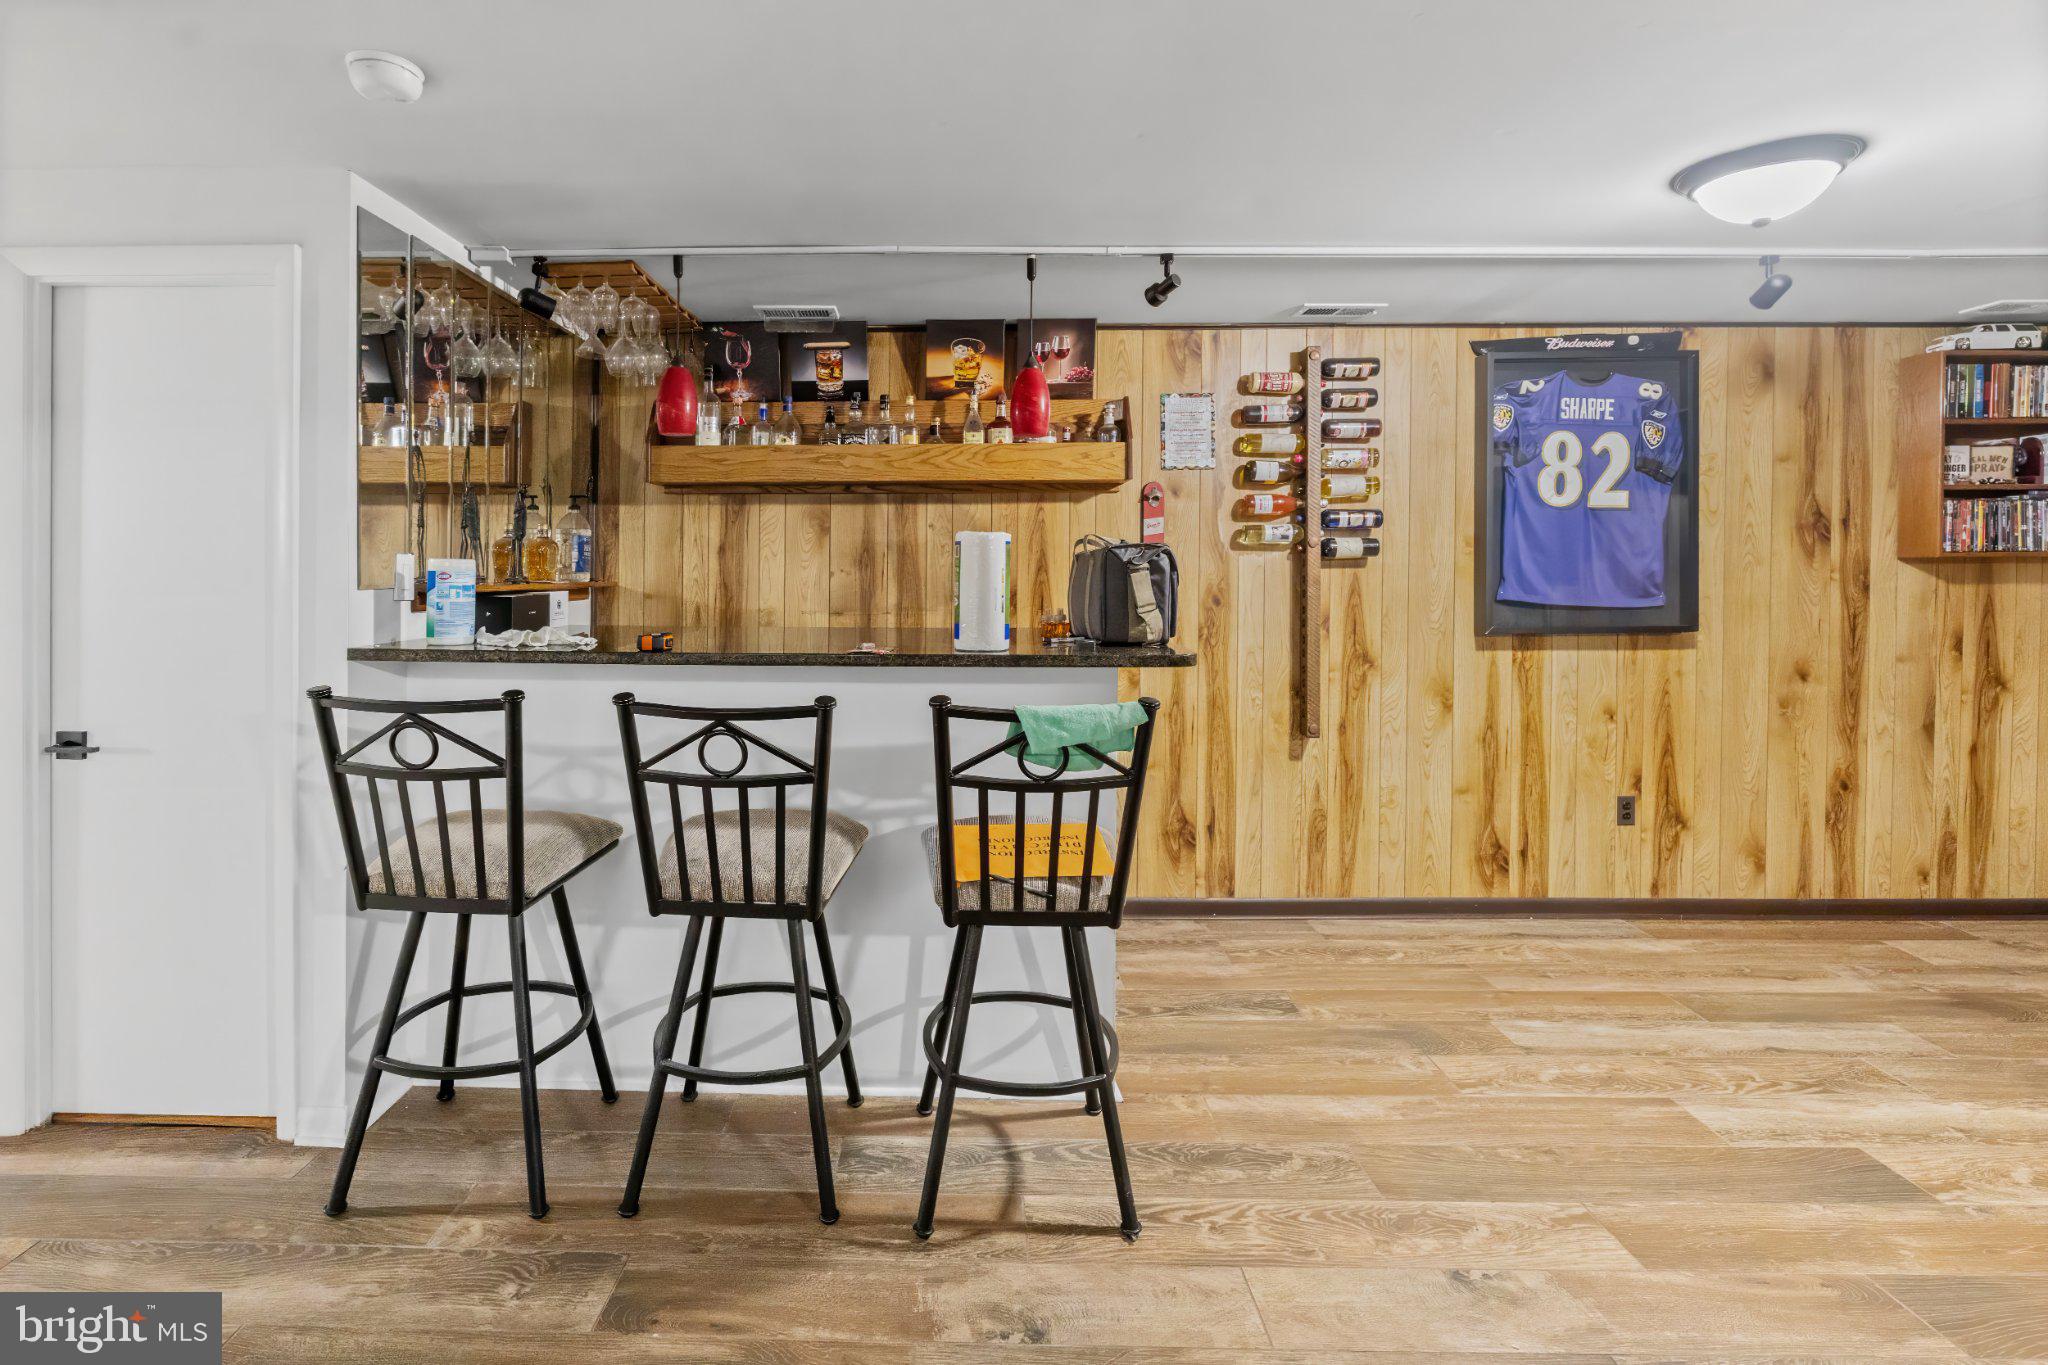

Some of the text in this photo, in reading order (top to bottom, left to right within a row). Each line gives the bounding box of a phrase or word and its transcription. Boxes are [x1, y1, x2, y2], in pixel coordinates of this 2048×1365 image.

[1545, 337, 1615, 351] Budweiser
[1560, 397, 1615, 420] SHARPE
[1538, 430, 1630, 508] 82
[1974, 463, 2001, 472] PRAY
